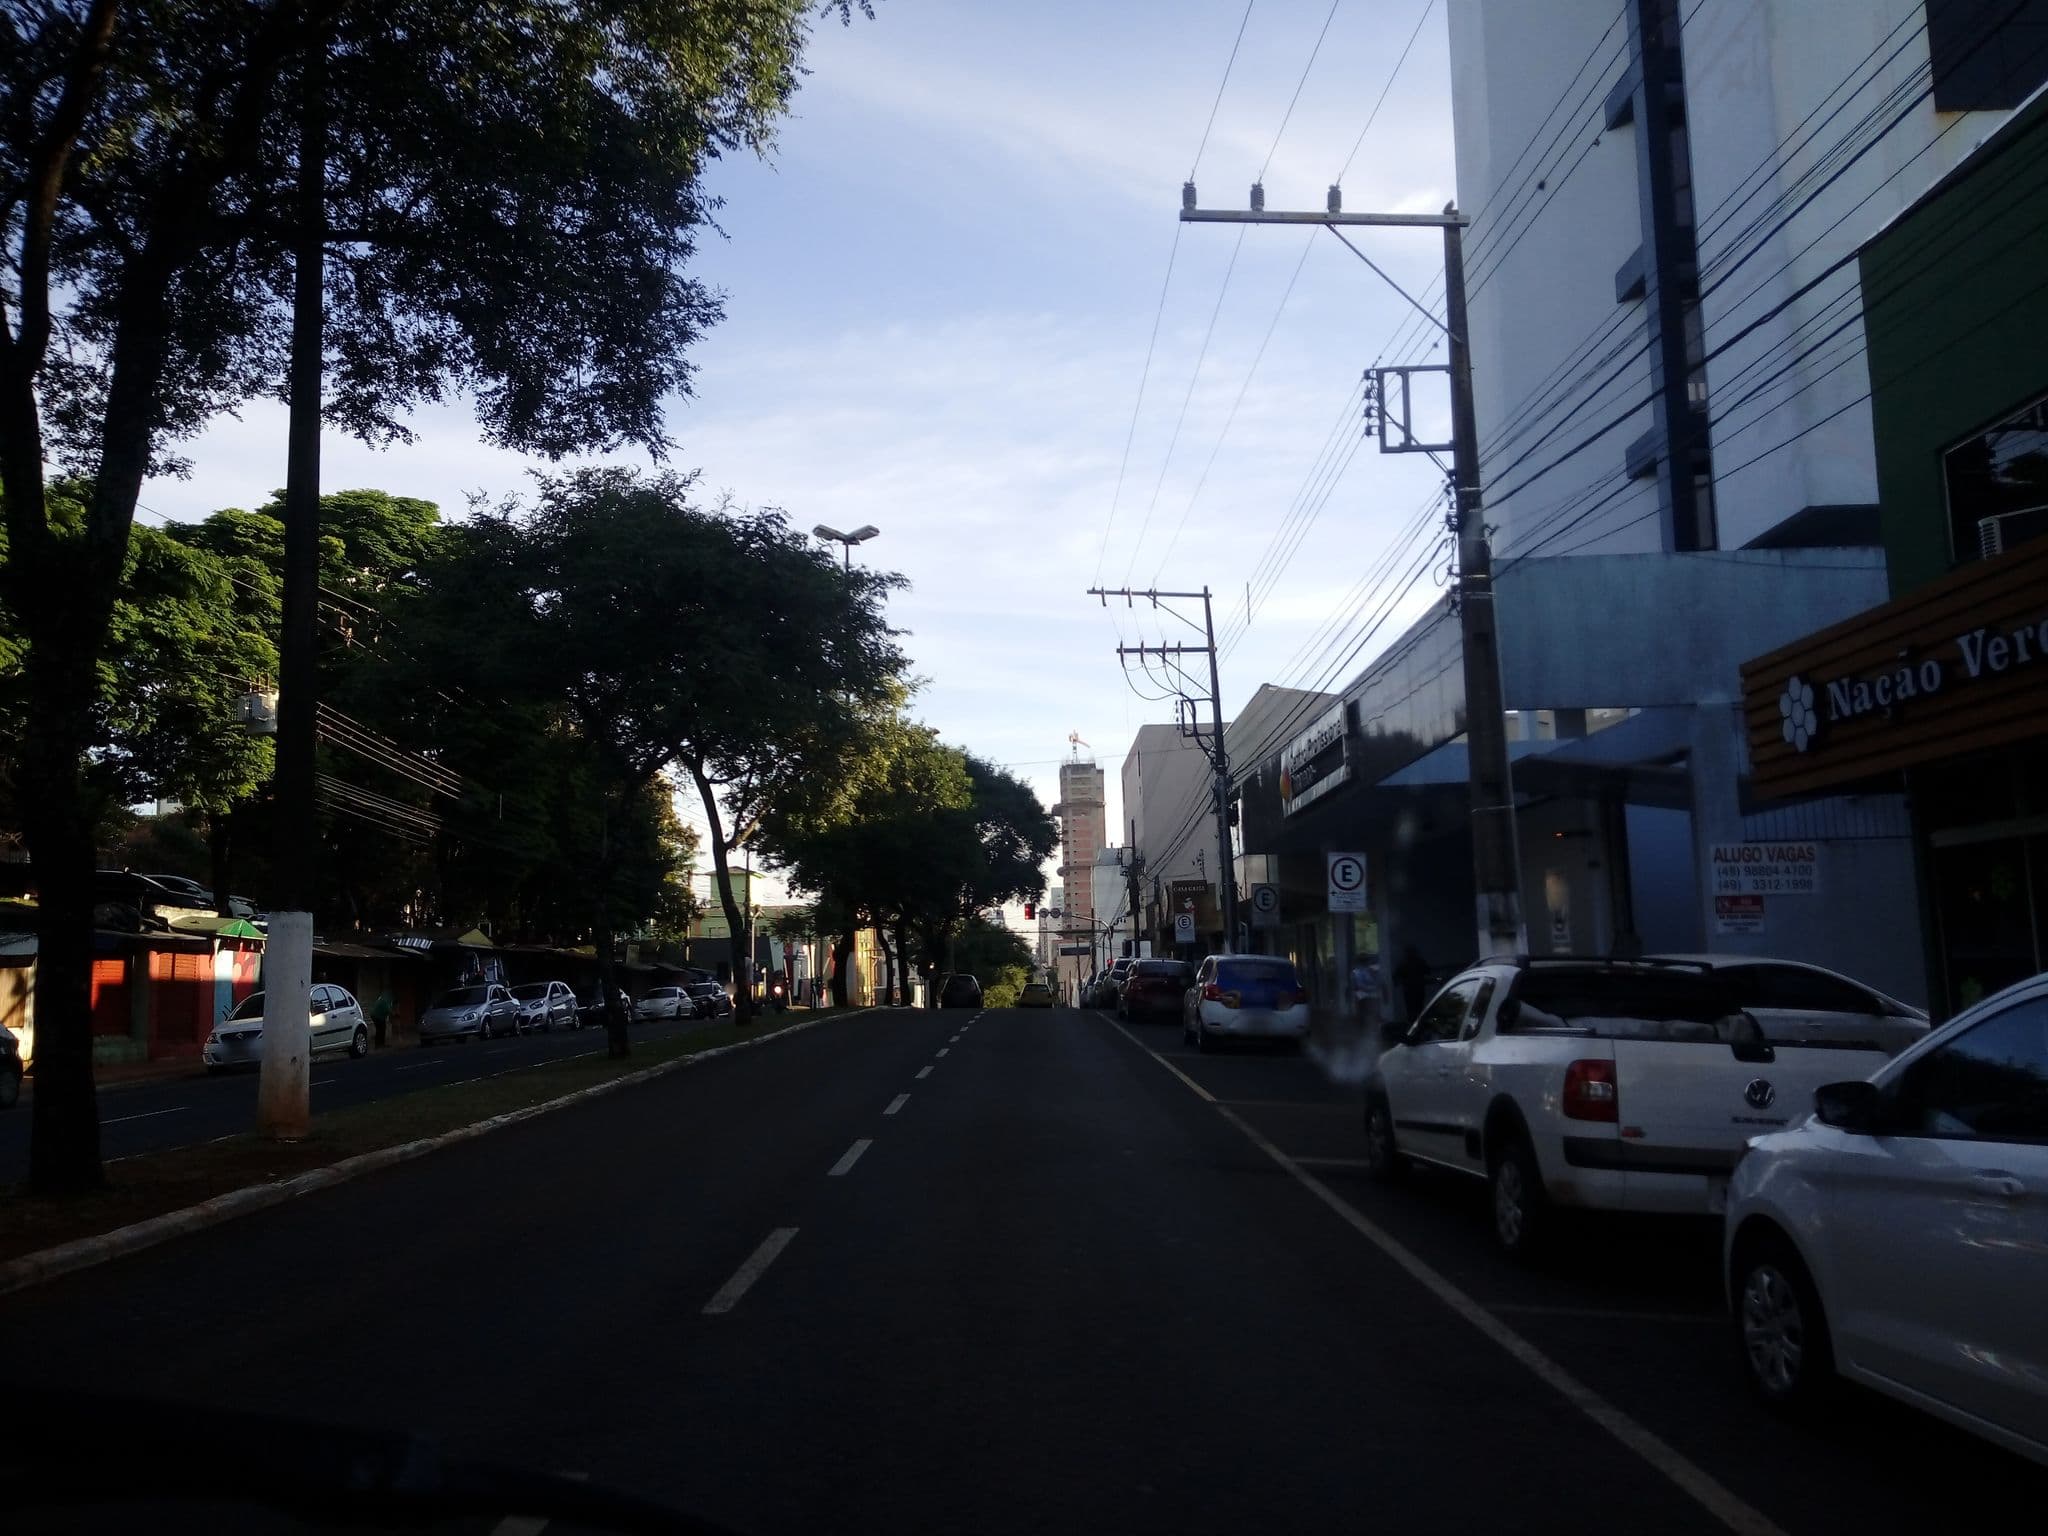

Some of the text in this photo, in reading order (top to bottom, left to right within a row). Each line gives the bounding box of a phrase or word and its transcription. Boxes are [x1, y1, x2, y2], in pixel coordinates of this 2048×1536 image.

[1826, 648, 1942, 721] Nação
[1714, 845, 1815, 864] ALUGO VAGAS
[1341, 864, 1353, 882] E
[1261, 892, 1270, 906] E
